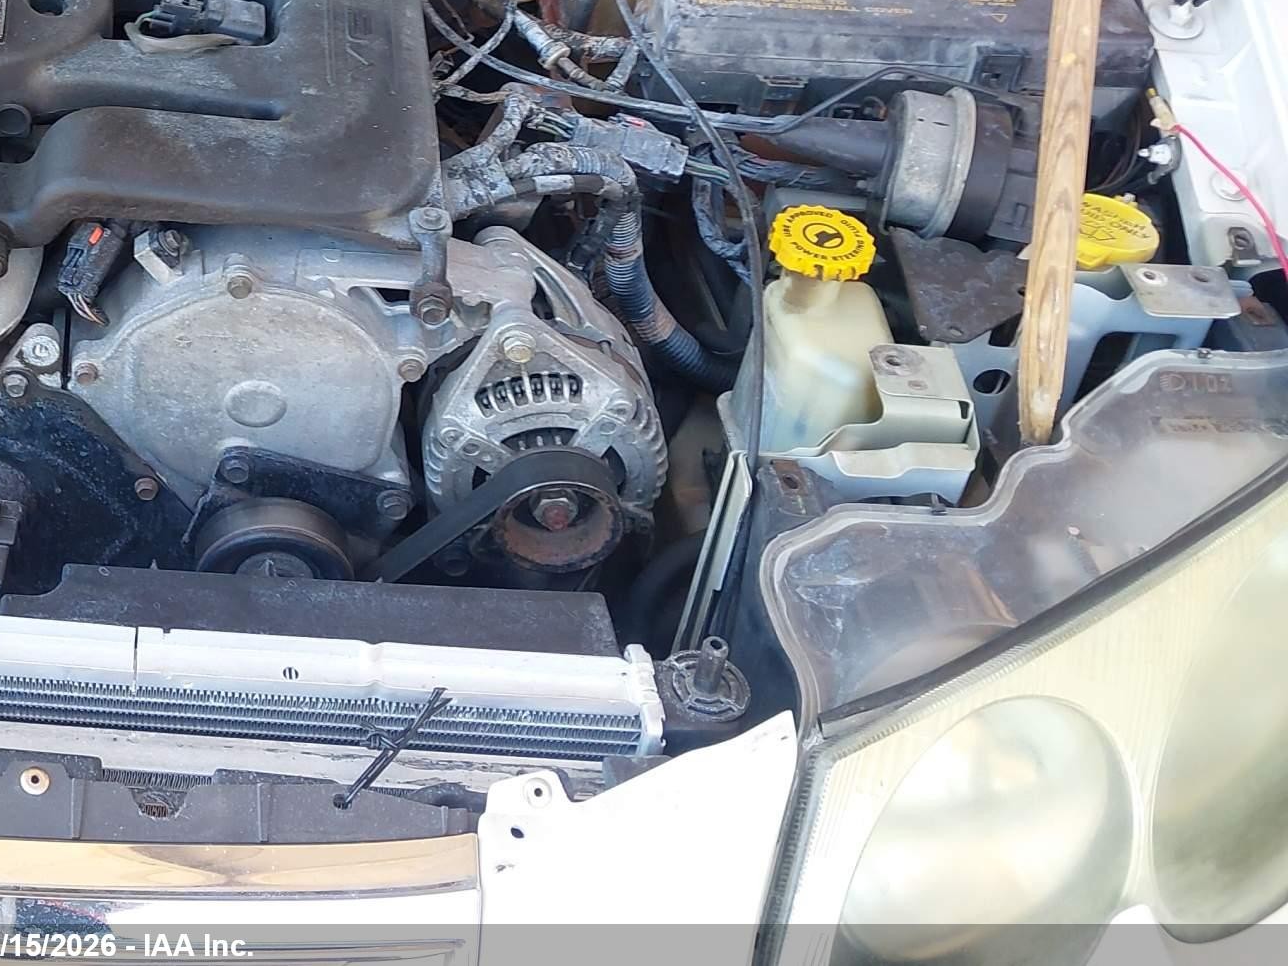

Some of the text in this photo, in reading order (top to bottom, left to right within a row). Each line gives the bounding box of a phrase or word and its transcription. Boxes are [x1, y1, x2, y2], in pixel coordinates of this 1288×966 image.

[864, 6, 913, 14] COVER
[786, 210, 834, 224] APPROVED
[791, 219, 865, 262] POWER STEERING FLUID
